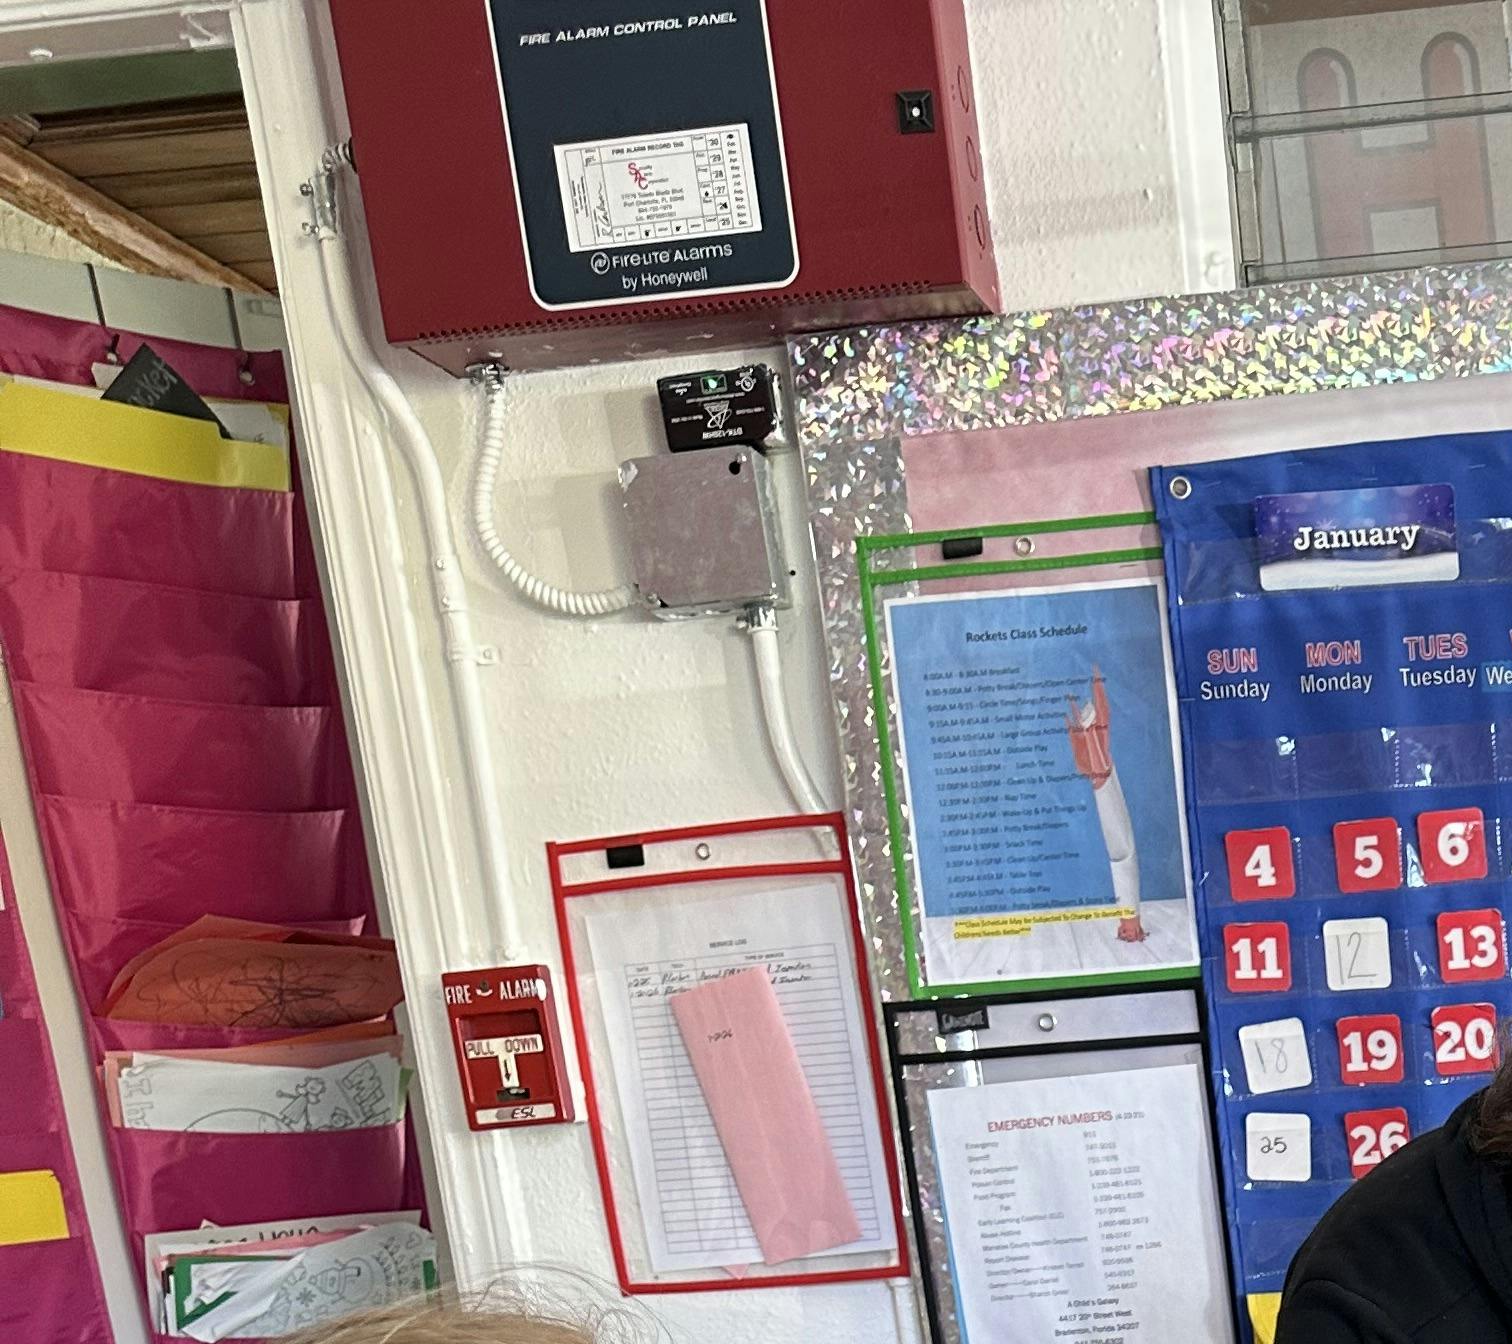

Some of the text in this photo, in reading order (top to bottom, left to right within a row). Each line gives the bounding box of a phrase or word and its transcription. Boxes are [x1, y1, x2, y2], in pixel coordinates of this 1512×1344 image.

[520, 12, 737, 46] FIRE ALARM CONTROL PANEL
[622, 267, 707, 291] by Honeywell
[1294, 522, 1420, 553] January
[966, 624, 1088, 643] Rockets Class Schedule
[1206, 648, 1258, 676] SUN
[1305, 640, 1362, 668] MON
[1403, 633, 1469, 661] TUES
[1200, 677, 1271, 702] Sunday
[1300, 670, 1373, 696] Monday
[1399, 664, 1478, 689] Tuesday
[1244, 821, 1469, 889] 4 5 6
[1231, 937, 1278, 980] 11
[1335, 931, 1377, 984] 12
[1444, 926, 1499, 970] 13
[445, 984, 472, 1005] FIRE
[465, 1037, 539, 1056] PULL DOWN
[1341, 1018, 1495, 1073] 19 20
[988, 1116, 1055, 1132] EMERGENCY
[1057, 1110, 1113, 1125] NUMBERS
[1259, 1136, 1288, 1155] 25
[1350, 1121, 1407, 1165] 26
